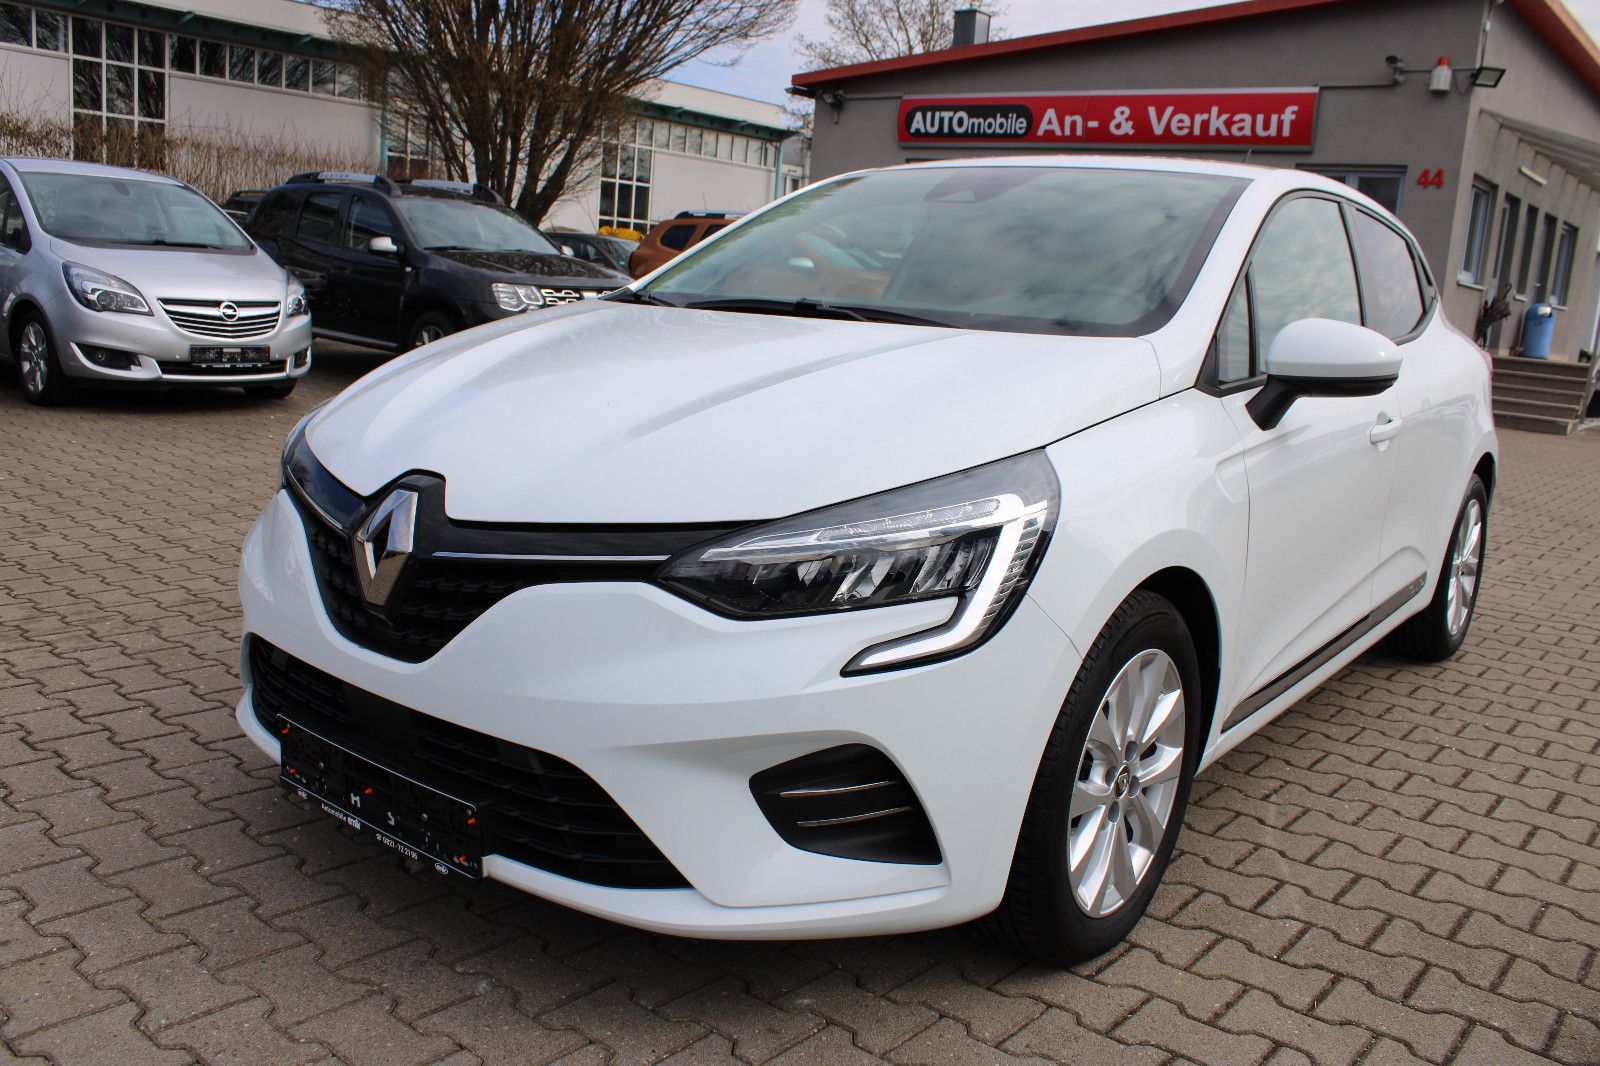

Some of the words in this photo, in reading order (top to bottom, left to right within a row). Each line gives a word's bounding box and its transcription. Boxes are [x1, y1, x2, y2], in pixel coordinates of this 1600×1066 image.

[910, 110, 1027, 134] AUTOmobile
[1036, 108, 1099, 137] An-
[1109, 106, 1135, 136] &
[1147, 105, 1299, 137] Verkauf
[1416, 168, 1444, 190] 44
